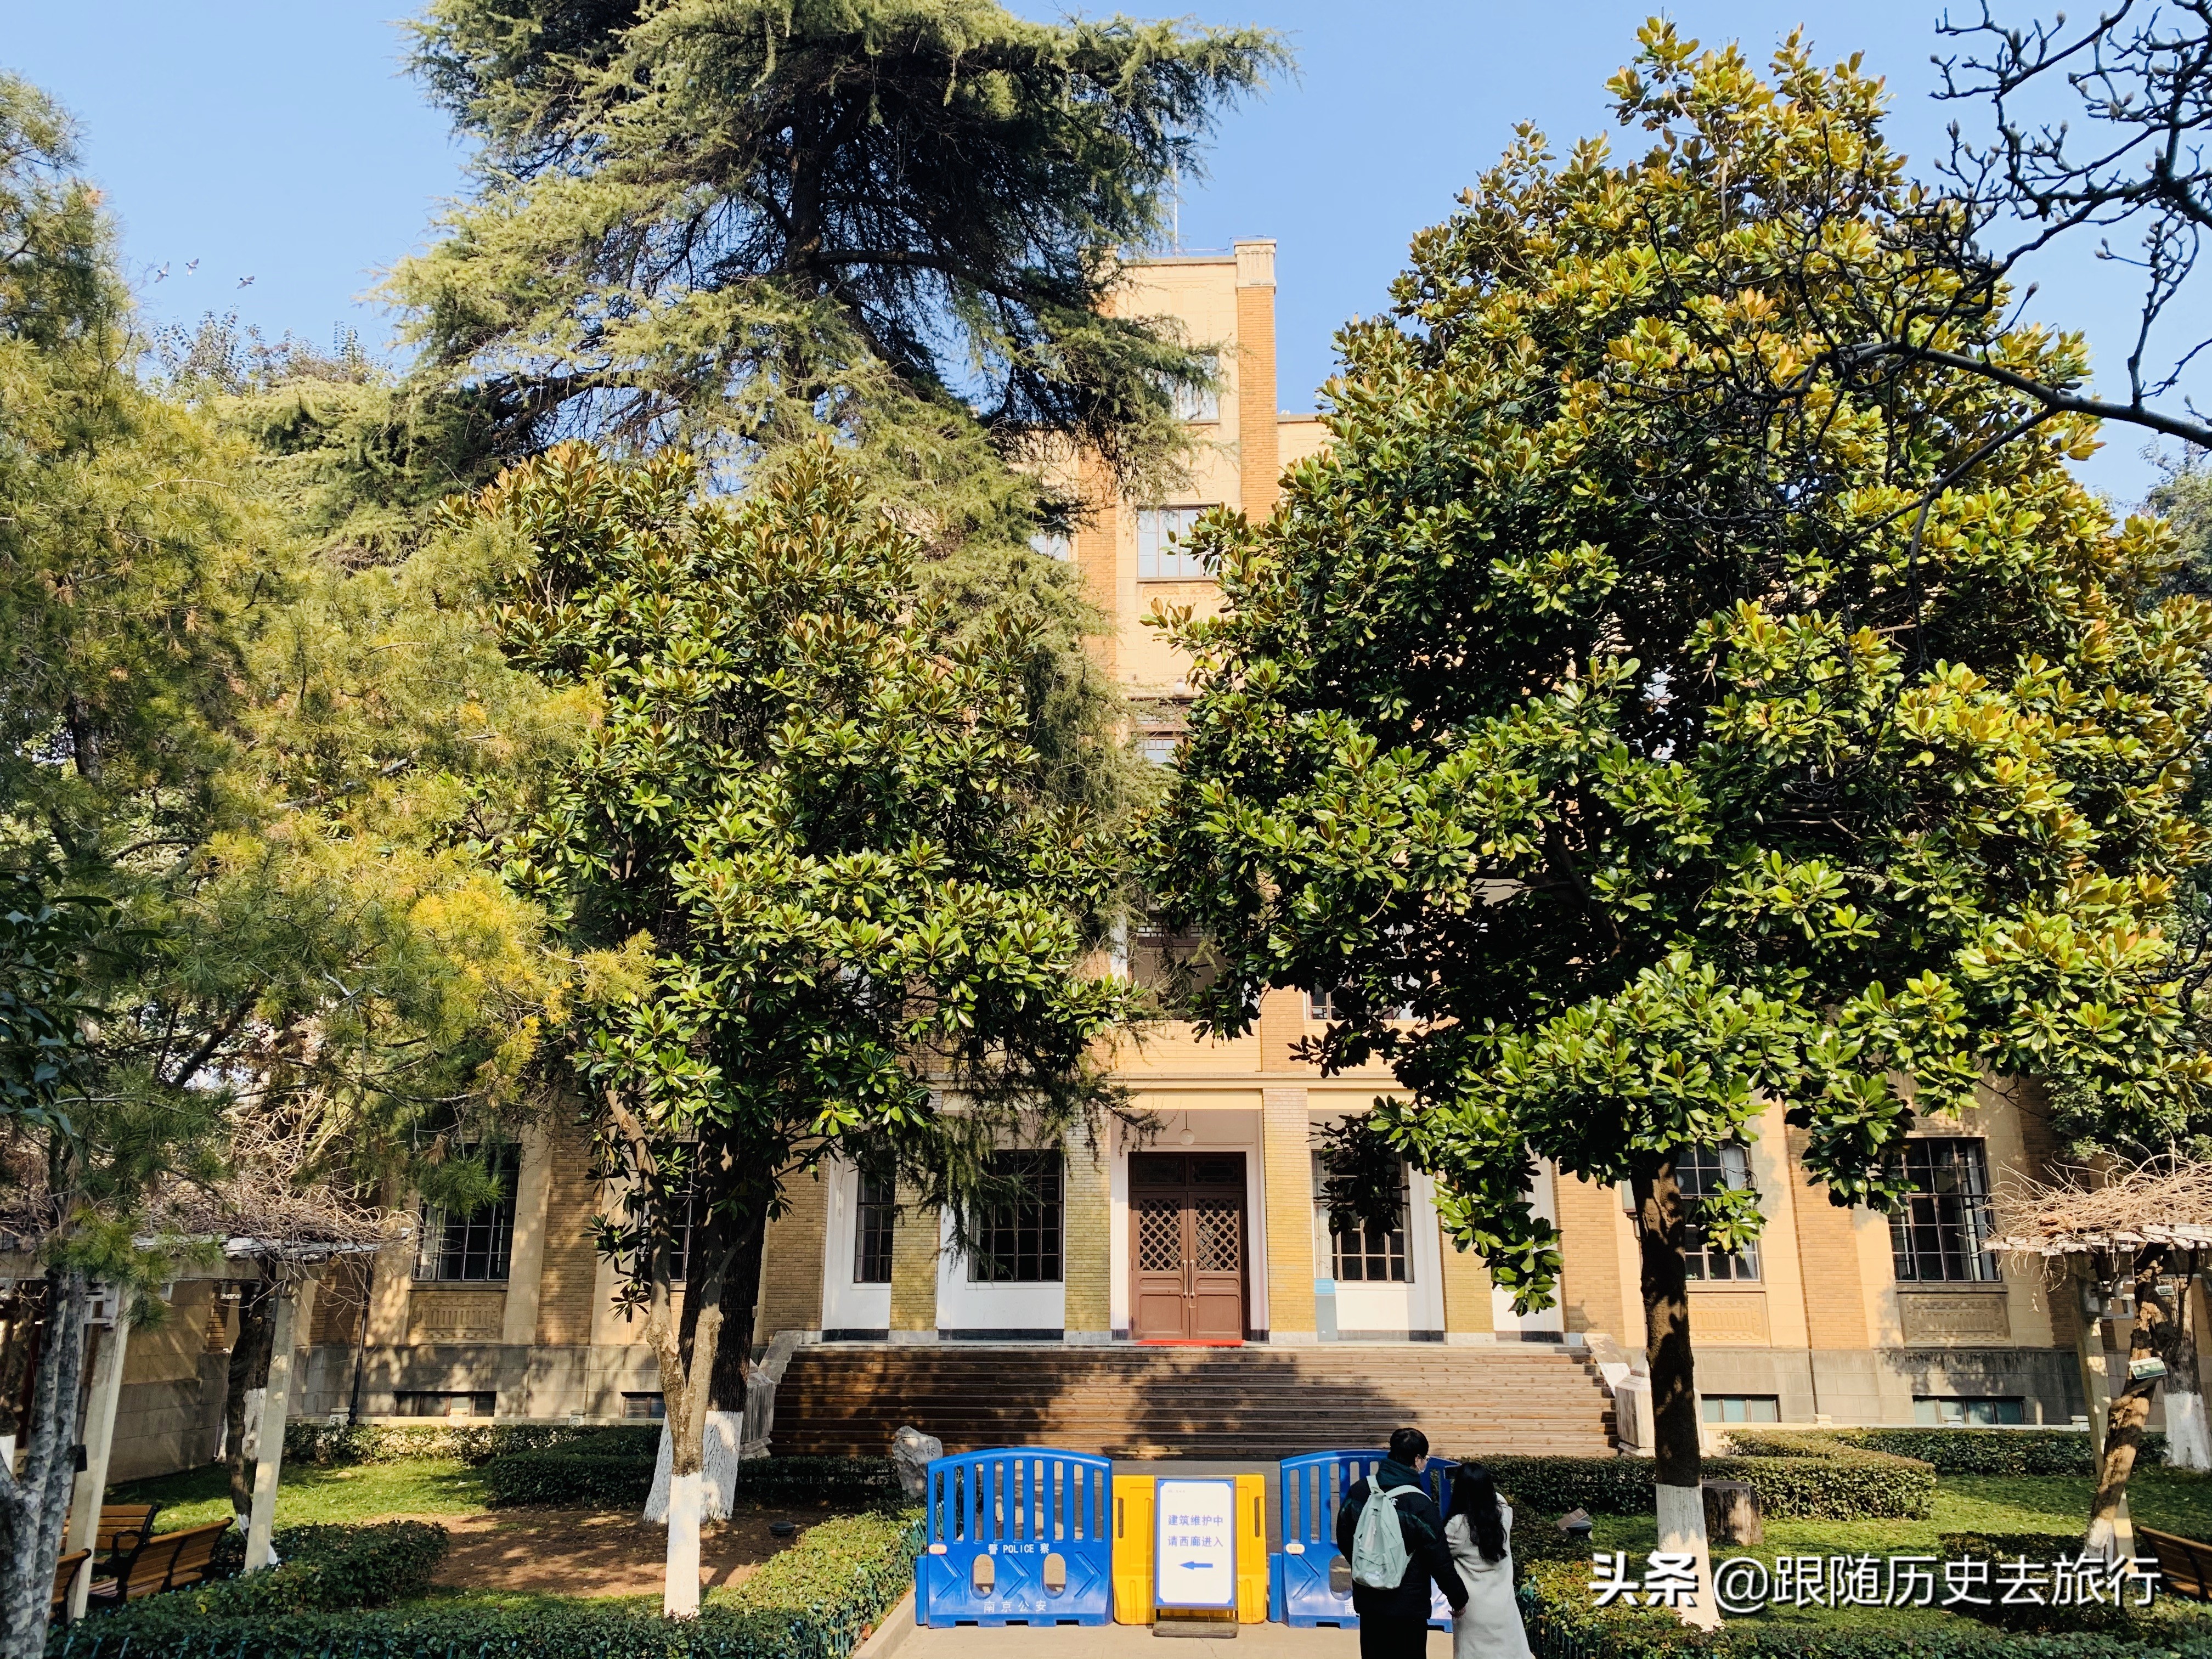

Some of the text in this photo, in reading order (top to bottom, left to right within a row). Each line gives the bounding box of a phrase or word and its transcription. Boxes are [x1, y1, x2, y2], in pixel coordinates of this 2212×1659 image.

[1167, 1514, 1223, 1527] 建筑维护中
[1167, 1535, 1223, 1547] 请西廊进入
[988, 1543, 1049, 1555] 警 POLICE 察
[984, 1599, 1047, 1613] 南京公安
